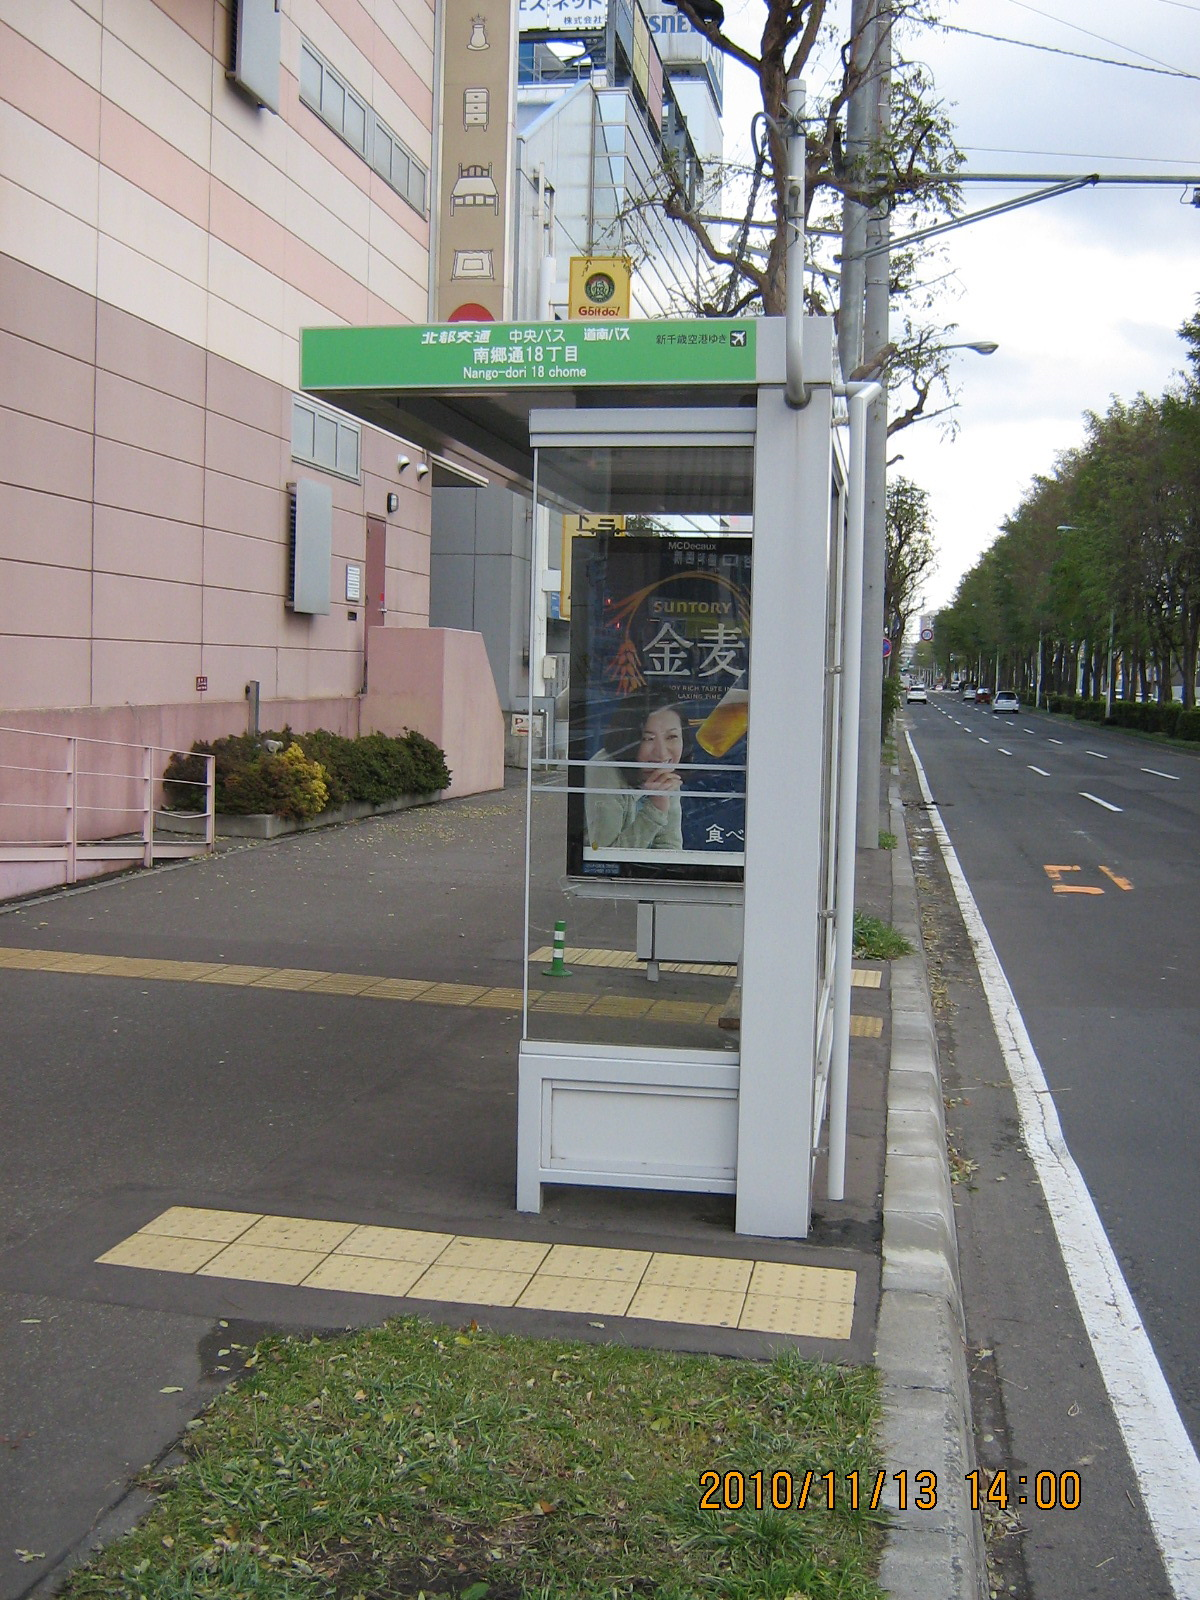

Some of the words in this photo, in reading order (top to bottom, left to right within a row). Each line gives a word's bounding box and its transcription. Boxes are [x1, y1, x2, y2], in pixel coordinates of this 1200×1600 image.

[564, 15, 602, 25] 株式会社
[421, 329, 492, 345] 北都交通
[509, 328, 566, 343] 中央バス
[583, 327, 631, 342] 道南バス
[656, 334, 727, 345] 新千歳空港ゆき
[473, 345, 579, 364] 南郷通18丁目
[463, 366, 527, 381] Nango-dori
[532, 366, 545, 378] 18
[548, 365, 587, 378] chome
[668, 541, 717, 550] MCDecaux
[642, 622, 746, 677] 金麦
